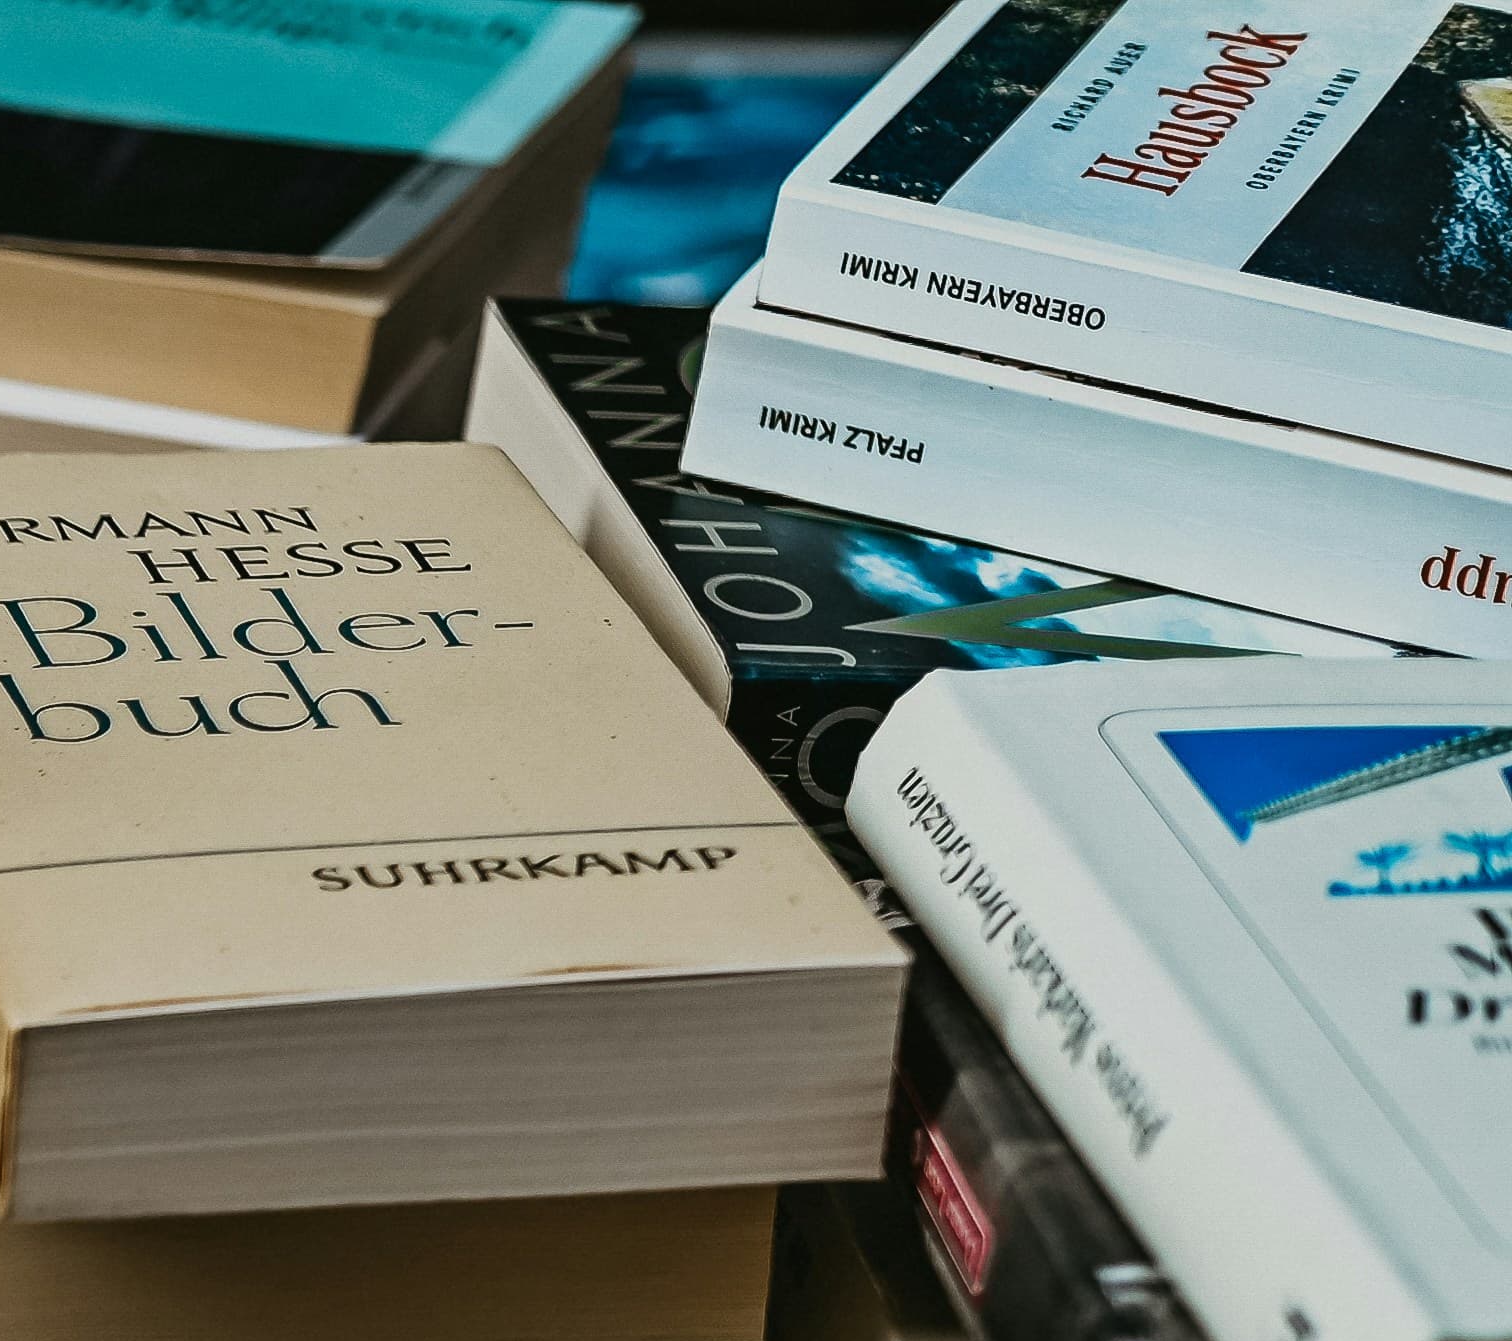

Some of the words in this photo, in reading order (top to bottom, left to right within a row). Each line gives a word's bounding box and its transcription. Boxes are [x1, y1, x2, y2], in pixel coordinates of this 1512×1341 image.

[1051, 78, 1115, 132] RICHARD
[1104, 41, 1148, 76] AUER
[1080, 24, 1311, 197] Hausbock
[1246, 110, 1327, 191] OBERBAYERN
[1316, 67, 1361, 107] KRIMI
[840, 252, 919, 290] KRIMI
[926, 270, 1107, 331] OBERBAYERN
[759, 405, 838, 445] KRIMI
[843, 425, 926, 465] PFALZ
[129, 538, 471, 584] HESSE
[897, 766, 975, 886] Grazien
[310, 844, 740, 894] SUHRKAMP
[960, 863, 1018, 943] Drei
